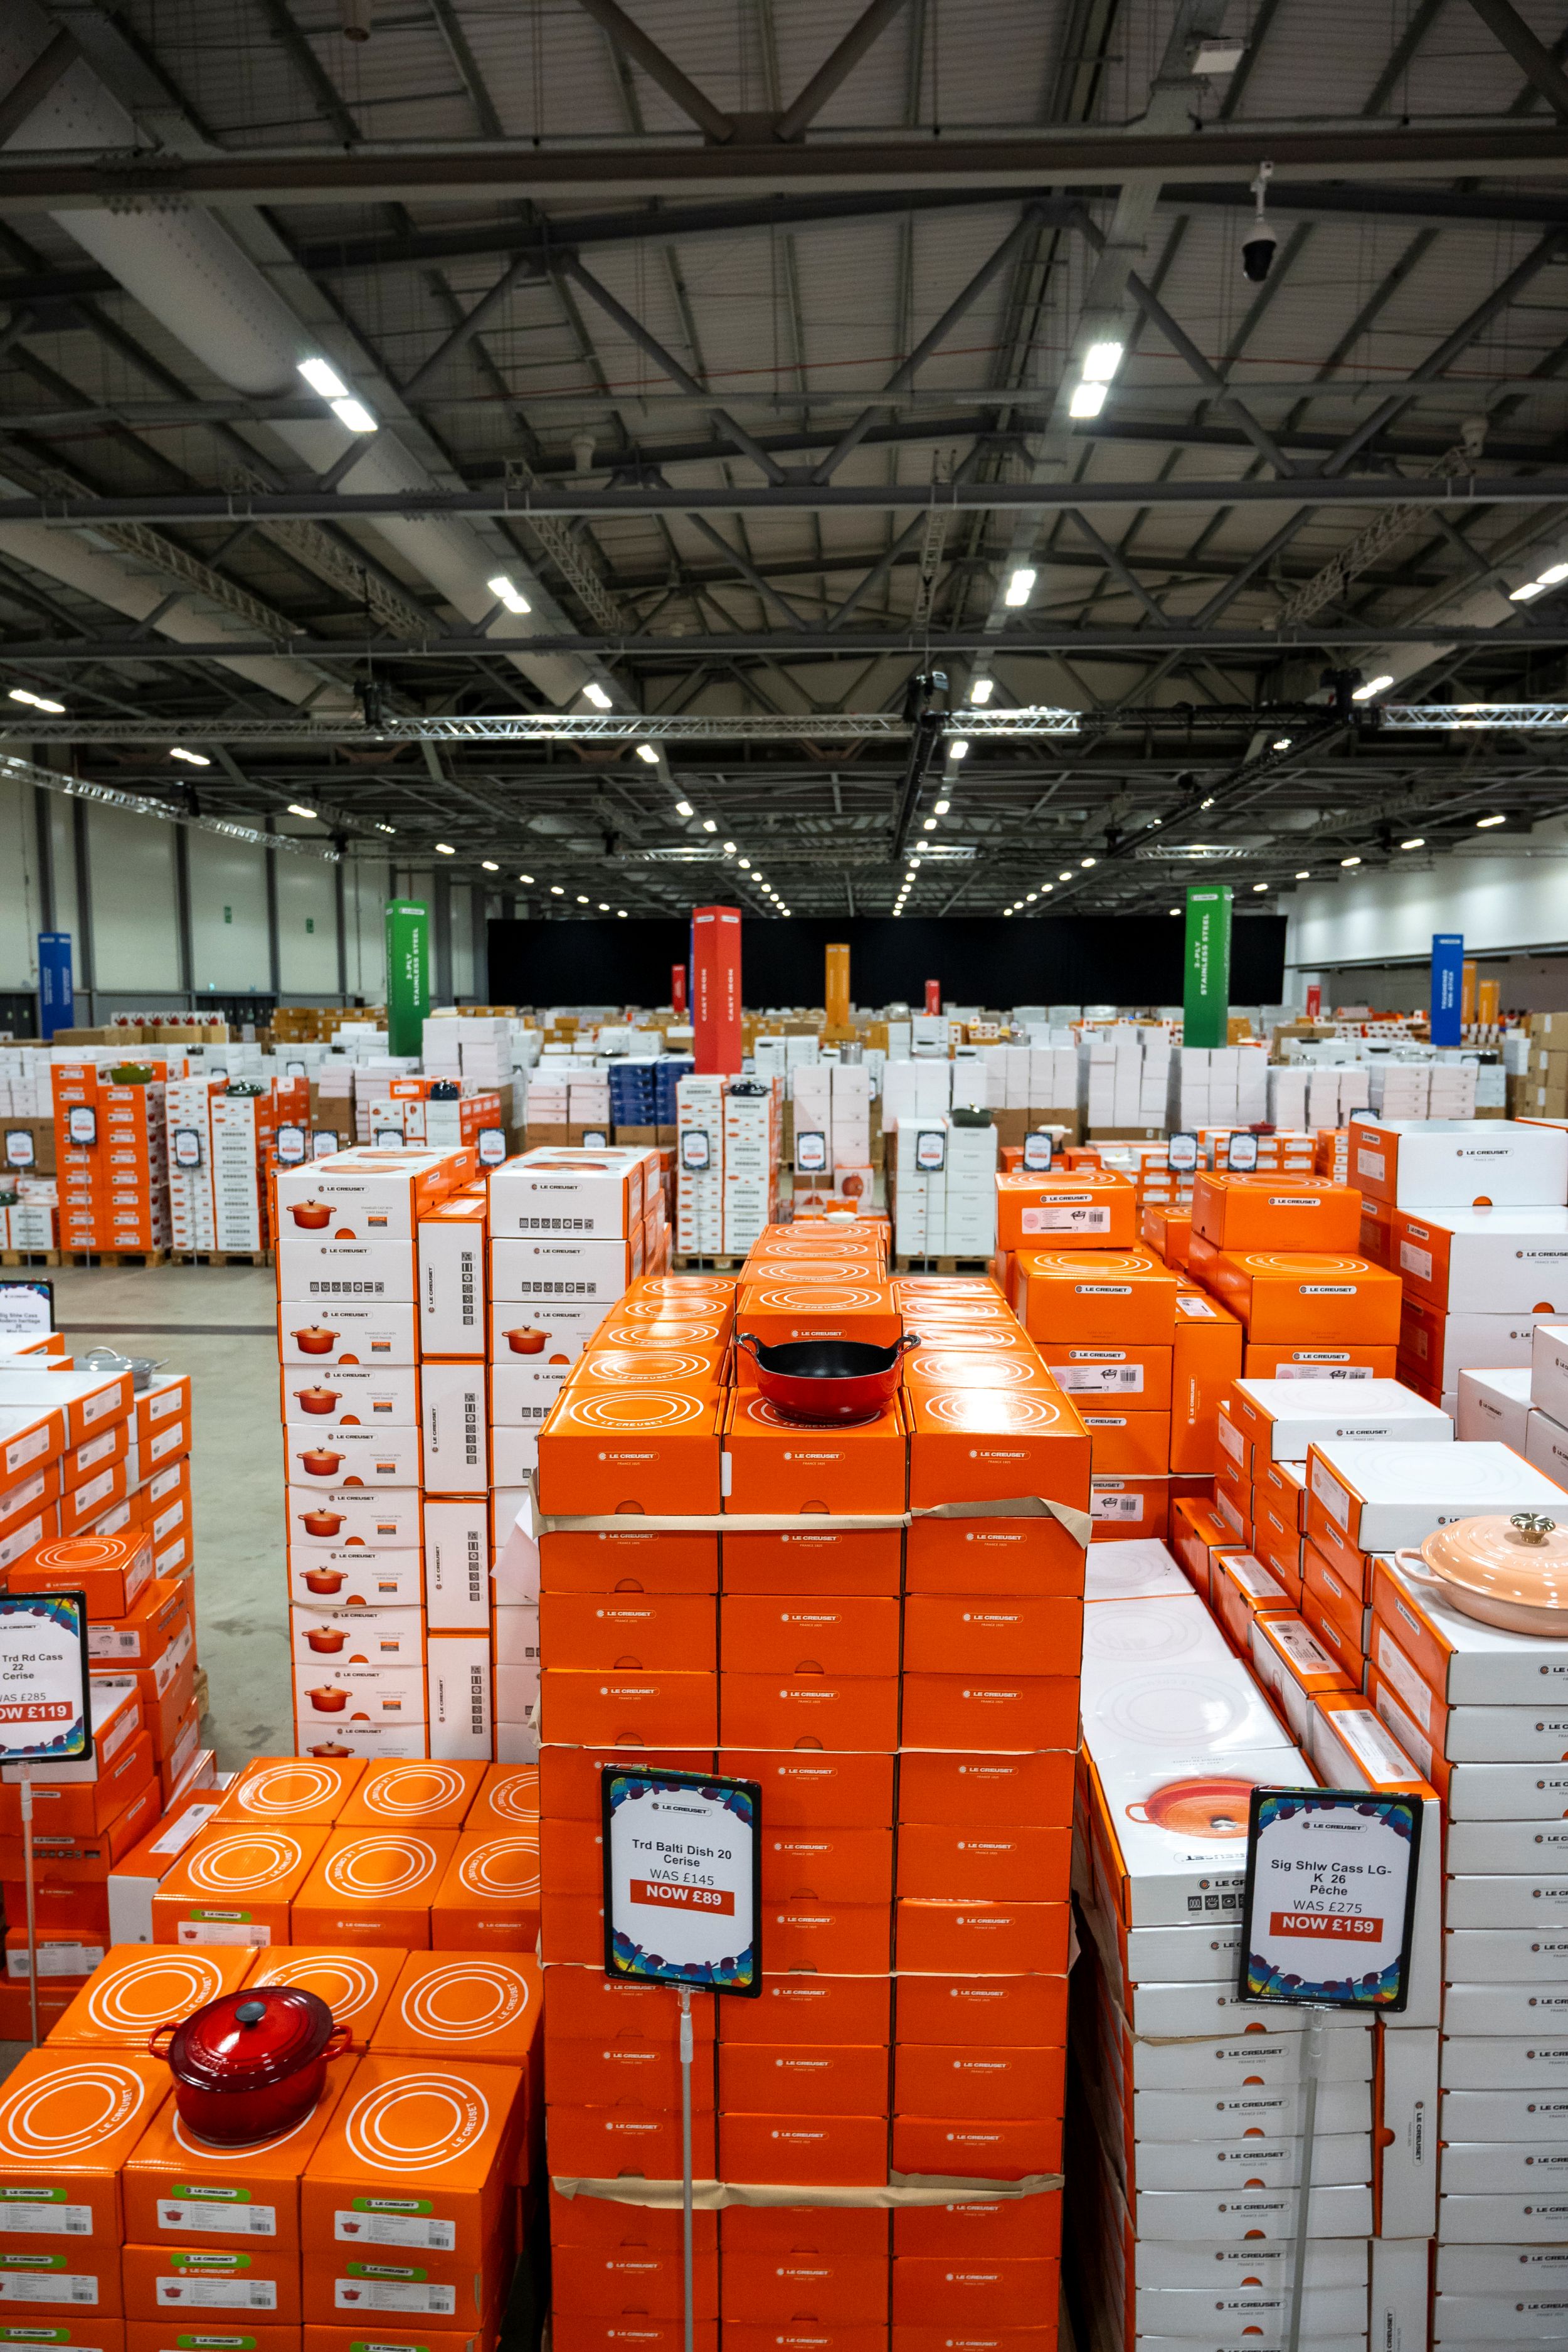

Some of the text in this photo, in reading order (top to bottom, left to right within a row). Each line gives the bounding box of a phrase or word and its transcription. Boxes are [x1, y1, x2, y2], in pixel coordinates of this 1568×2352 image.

[1190, 1407, 1194, 1416] LE
[21, 1693, 46, 1701] £285
[0, 1705, 66, 1719] OW £119
[632, 1839, 732, 1860] Trd Balti Dish 20
[270, 1849, 293, 1878] LE CREUSET
[334, 1858, 347, 1880] CREUSET
[664, 1854, 701, 1867] Cerise
[1271, 1859, 1392, 1875] Sig Shlw Cass LG-
[649, 1869, 714, 1887] WAS £145
[1314, 1873, 1346, 1884] K 26
[647, 1884, 723, 1905] NOW £89
[1310, 1885, 1347, 1895] Pêche
[1293, 1900, 1362, 1914] WAS £275
[1283, 1916, 1375, 1933] NOW £159
[184, 1976, 212, 2013] LE CREUSET
[497, 1983, 518, 2020] LE CREUSET
[98, 2089, 132, 2134] LE CREUSET
[1416, 2112, 1421, 2123] LE
[452, 2102, 478, 2149] LE CREUSET
